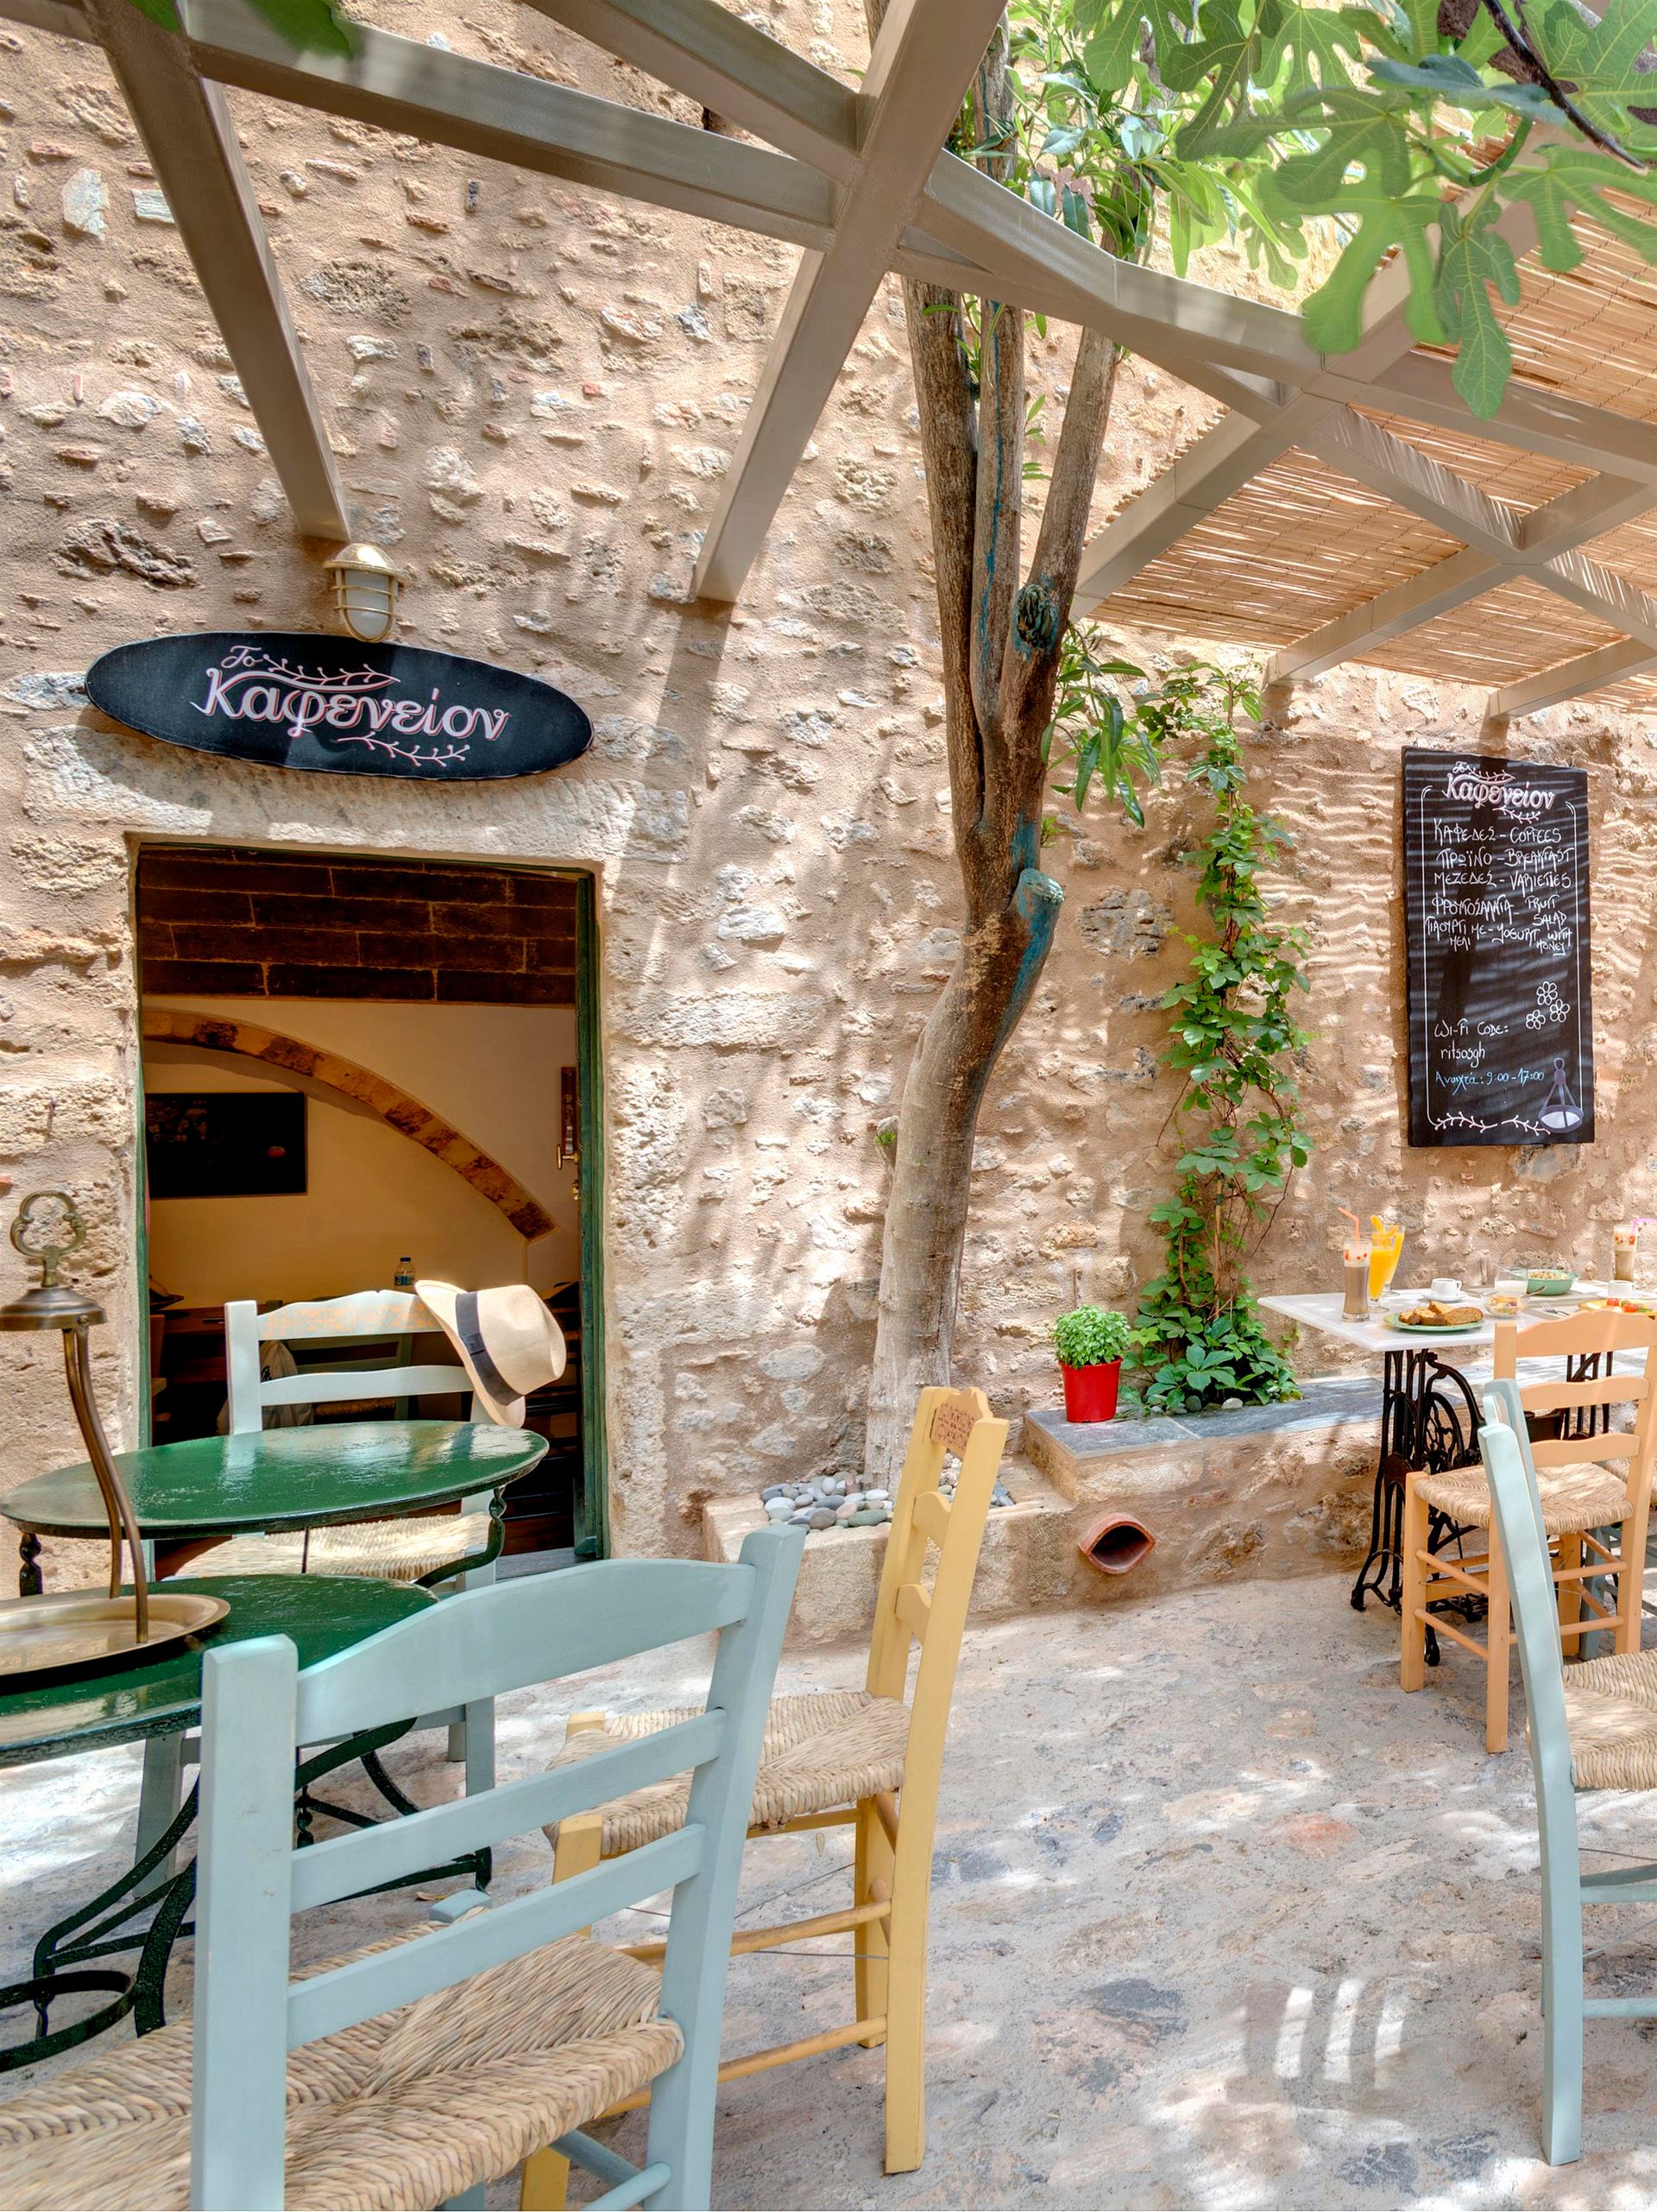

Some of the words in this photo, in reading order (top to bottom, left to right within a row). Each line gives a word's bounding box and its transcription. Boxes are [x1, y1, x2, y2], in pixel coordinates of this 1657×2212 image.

[190, 668, 512, 740] Καφενείον
[1441, 773, 1556, 810] Καφενείον
[1504, 846, 1575, 873] BREAKFAST
[1509, 870, 1572, 898] VARIETIES
[1525, 894, 1559, 913] FRUIT
[1532, 911, 1567, 930] SALAD
[1492, 923, 1540, 947] YOGURT
[1547, 927, 1572, 947] WITH
[1536, 939, 1566, 955] HONEY
[1440, 1039, 1485, 1068] ritsosgh
